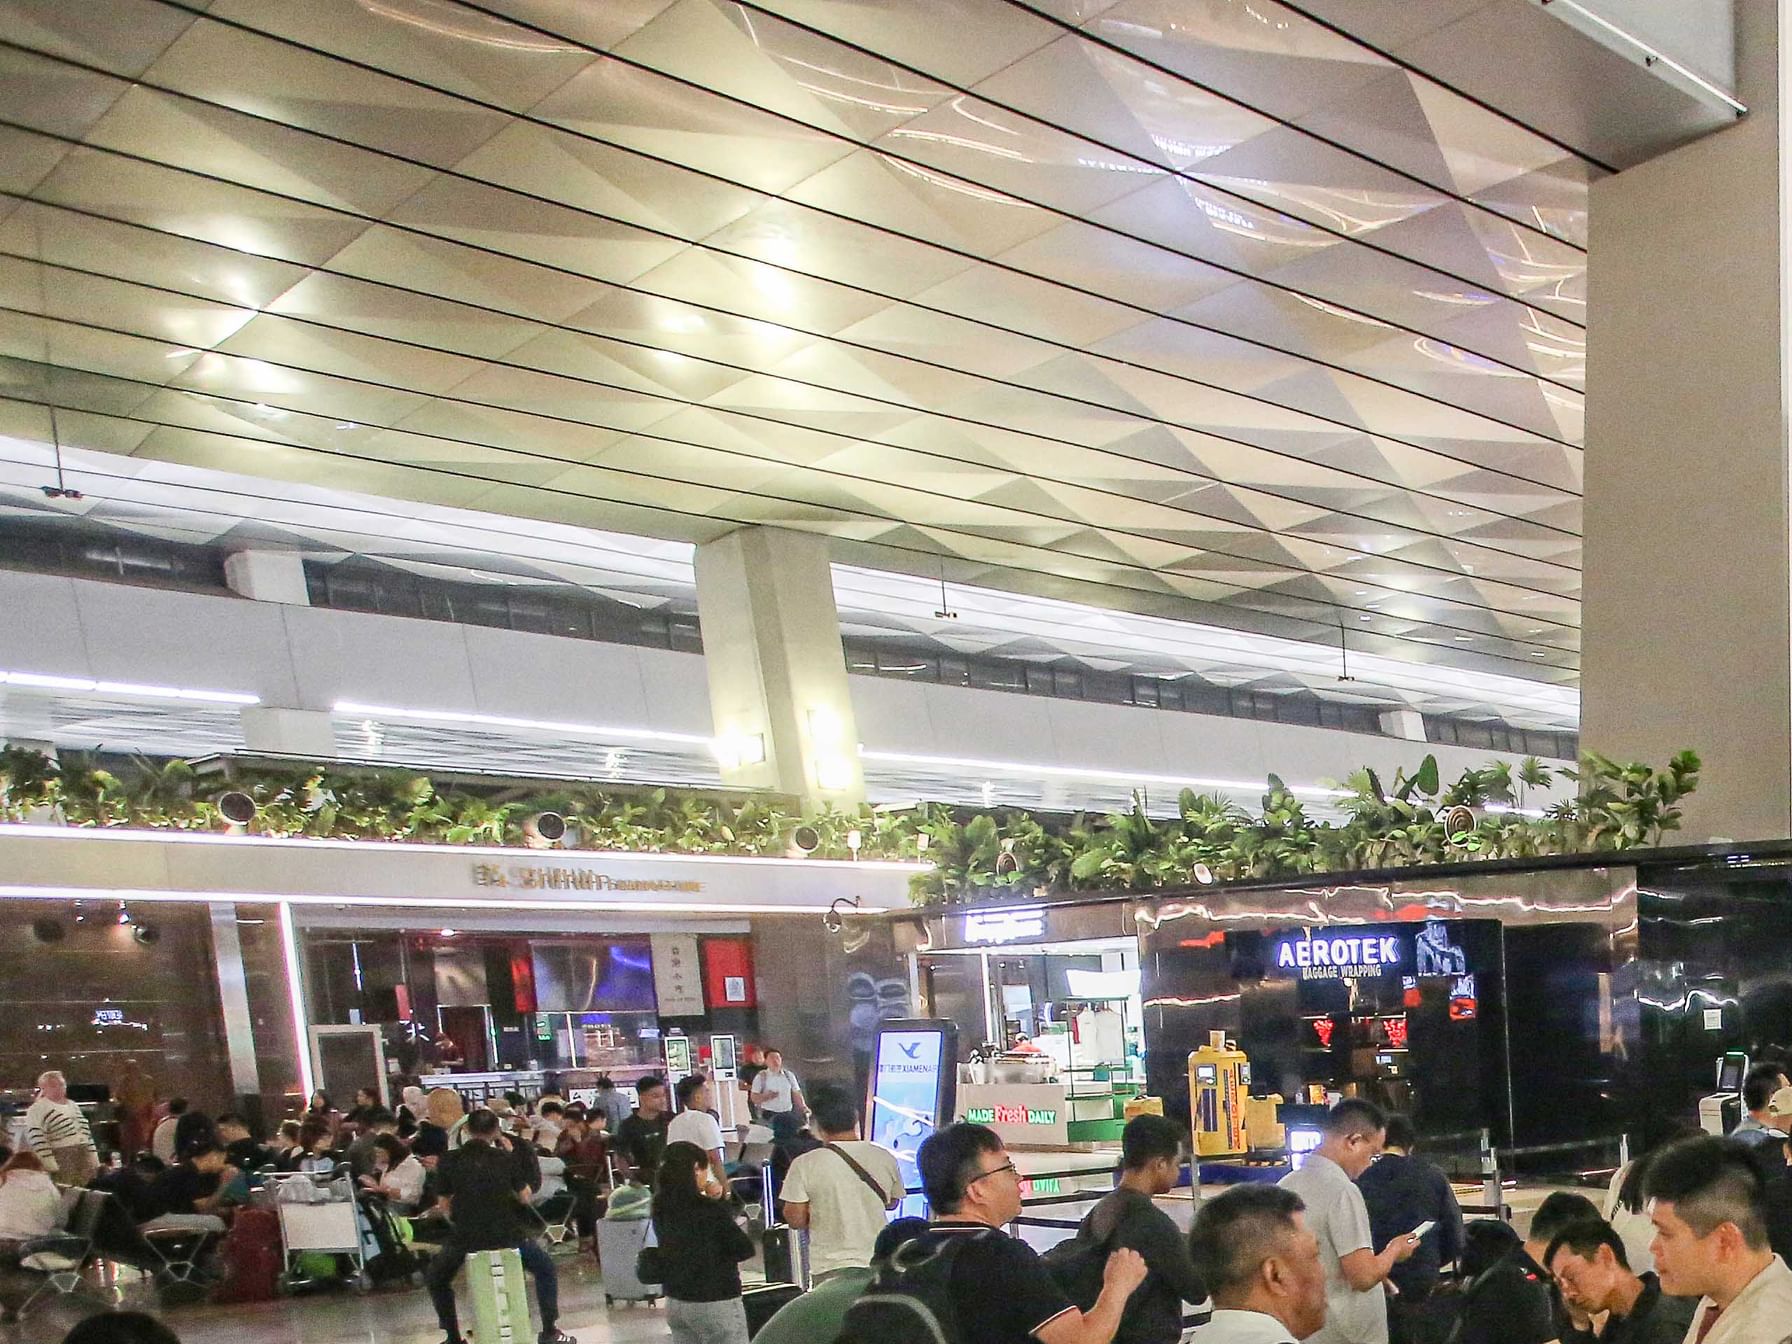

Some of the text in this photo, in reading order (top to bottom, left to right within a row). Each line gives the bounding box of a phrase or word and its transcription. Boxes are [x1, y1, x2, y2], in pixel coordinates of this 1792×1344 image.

[1279, 936, 1399, 967] AEROTEK
[1302, 963, 1382, 980] BAGGAGE WRAPPING
[968, 1104, 1056, 1124] MADE Fresh DAILY
